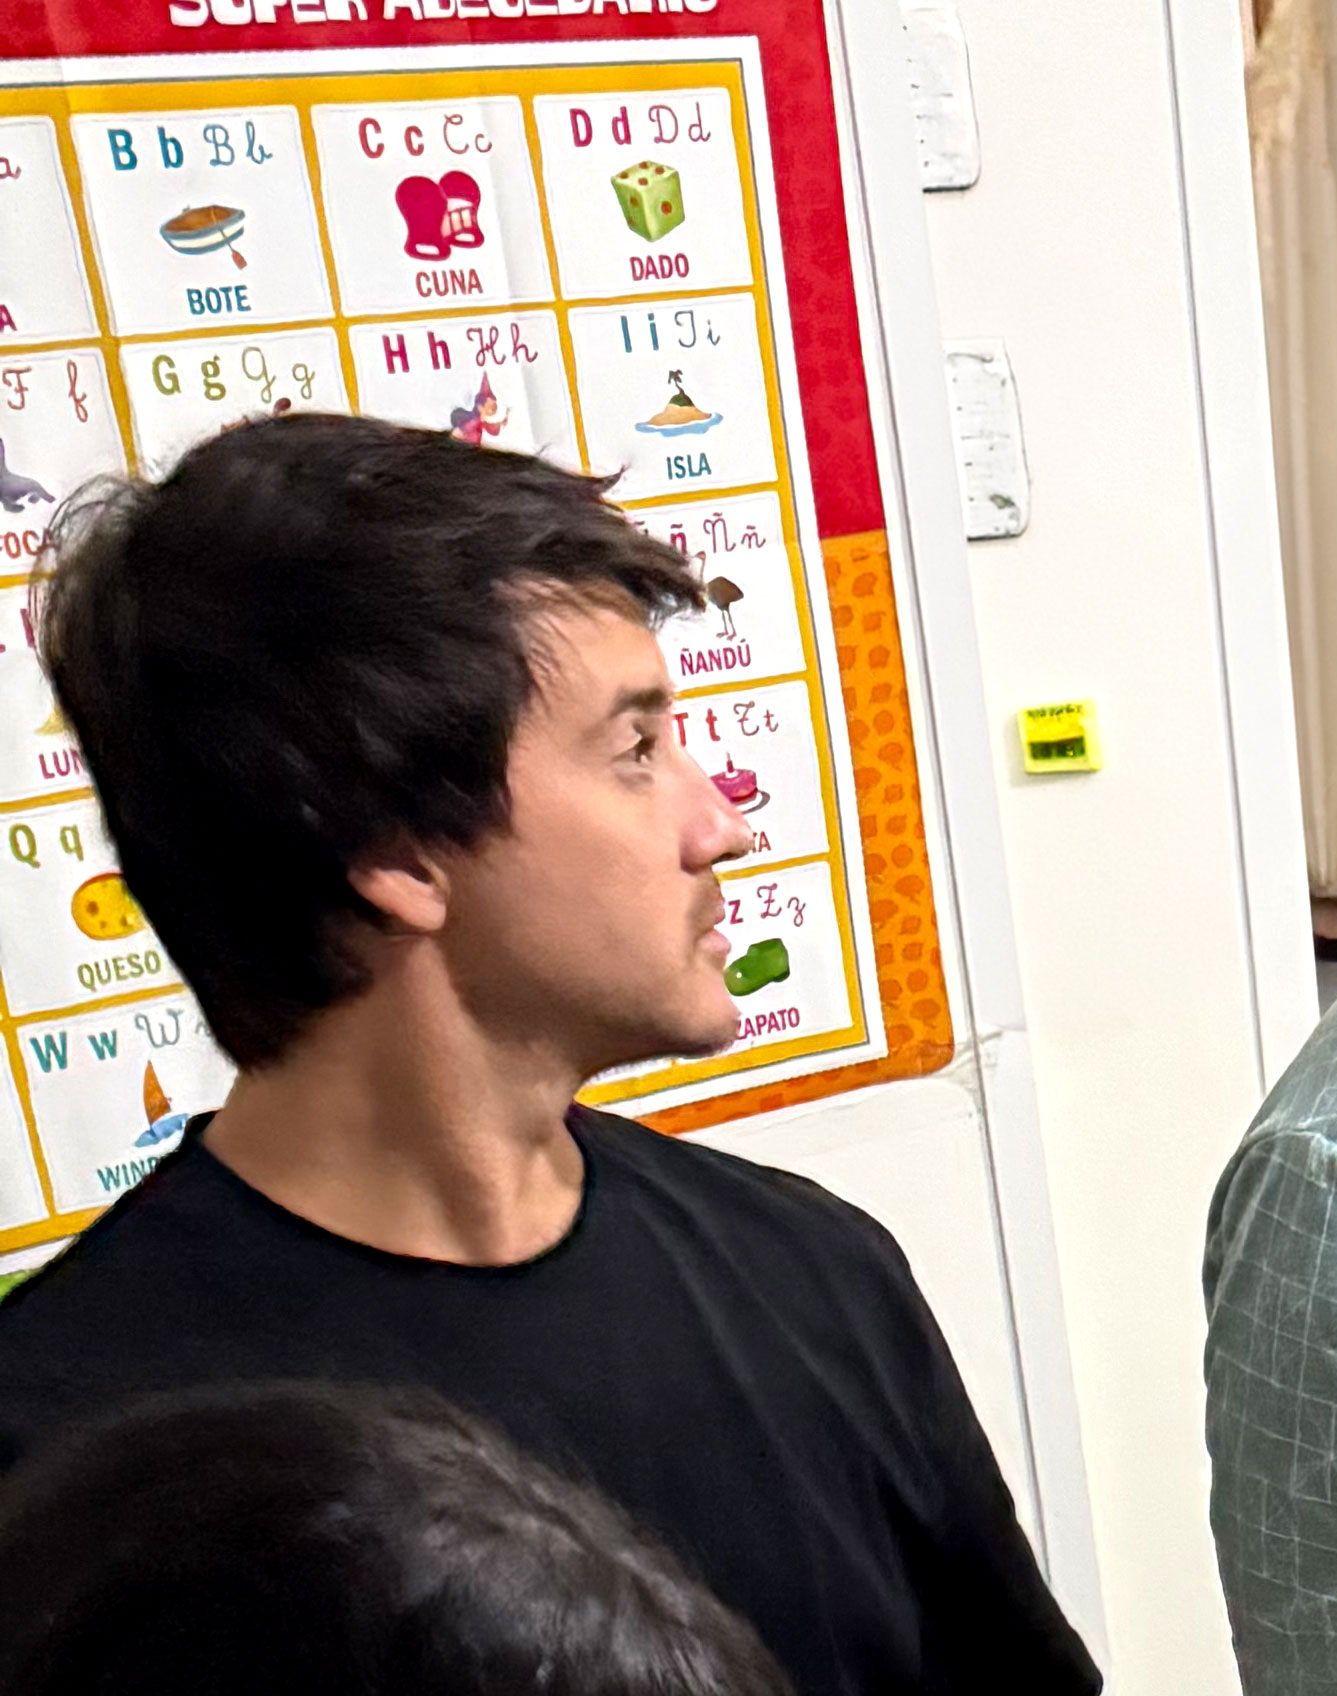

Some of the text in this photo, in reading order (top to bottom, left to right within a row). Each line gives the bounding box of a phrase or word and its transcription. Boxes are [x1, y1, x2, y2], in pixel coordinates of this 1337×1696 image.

[629, 252, 690, 281] DADO
[415, 267, 484, 298] CUNA
[186, 285, 251, 316] BOTE
[666, 453, 712, 480] ISLA
[679, 639, 752, 676] ÑANDÚ
[77, 949, 161, 992] QUESO
